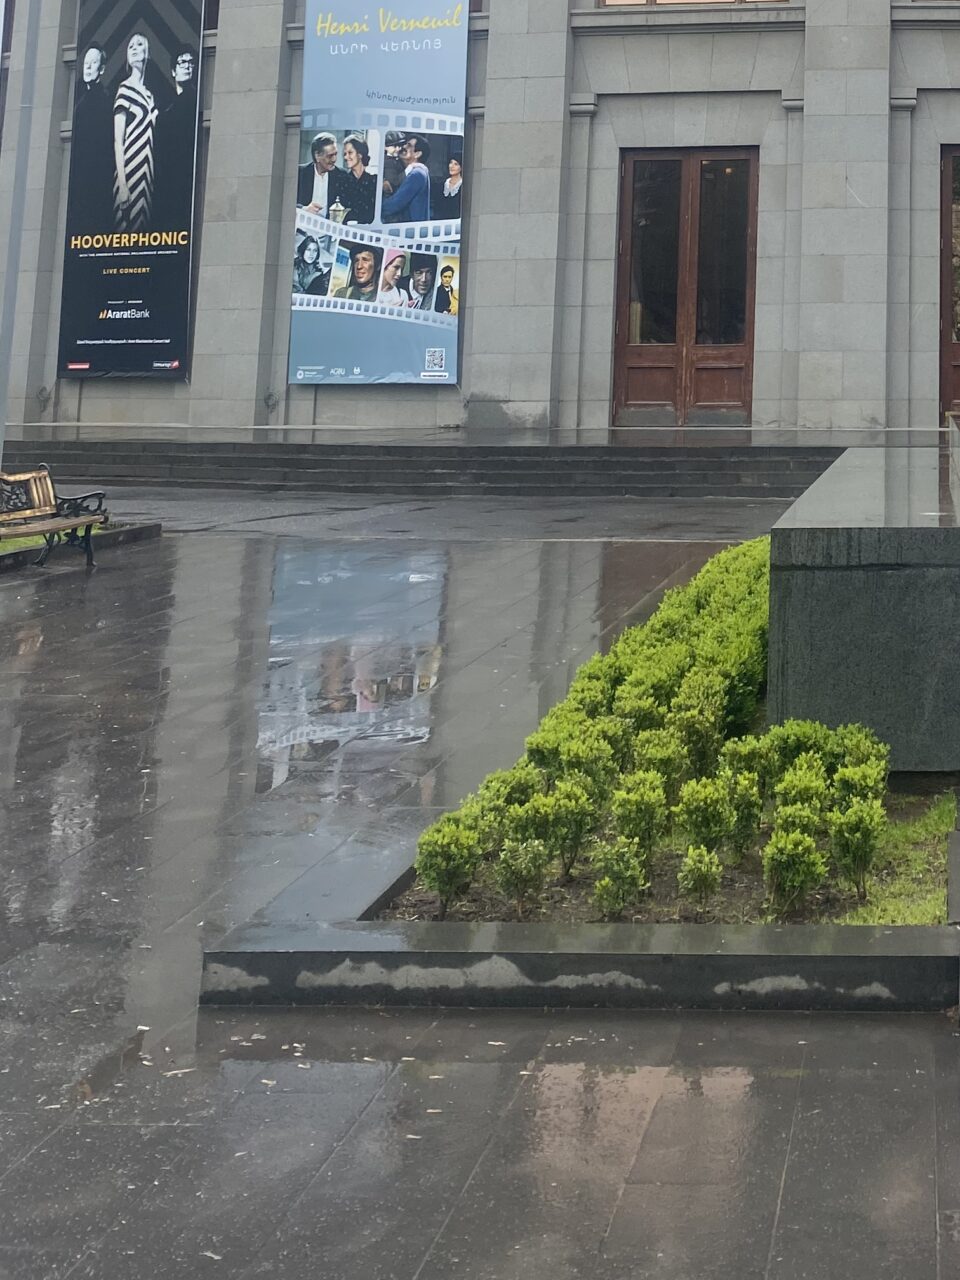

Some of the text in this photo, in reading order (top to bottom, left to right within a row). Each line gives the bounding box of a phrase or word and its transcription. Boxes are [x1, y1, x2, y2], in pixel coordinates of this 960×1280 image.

[316, 3, 463, 38] Henri Verneuil
[330, 42, 369, 55] ԱՆՐԻ
[71, 231, 189, 249] HOOVERPHONIC
[106, 309, 150, 319] AraratBank
